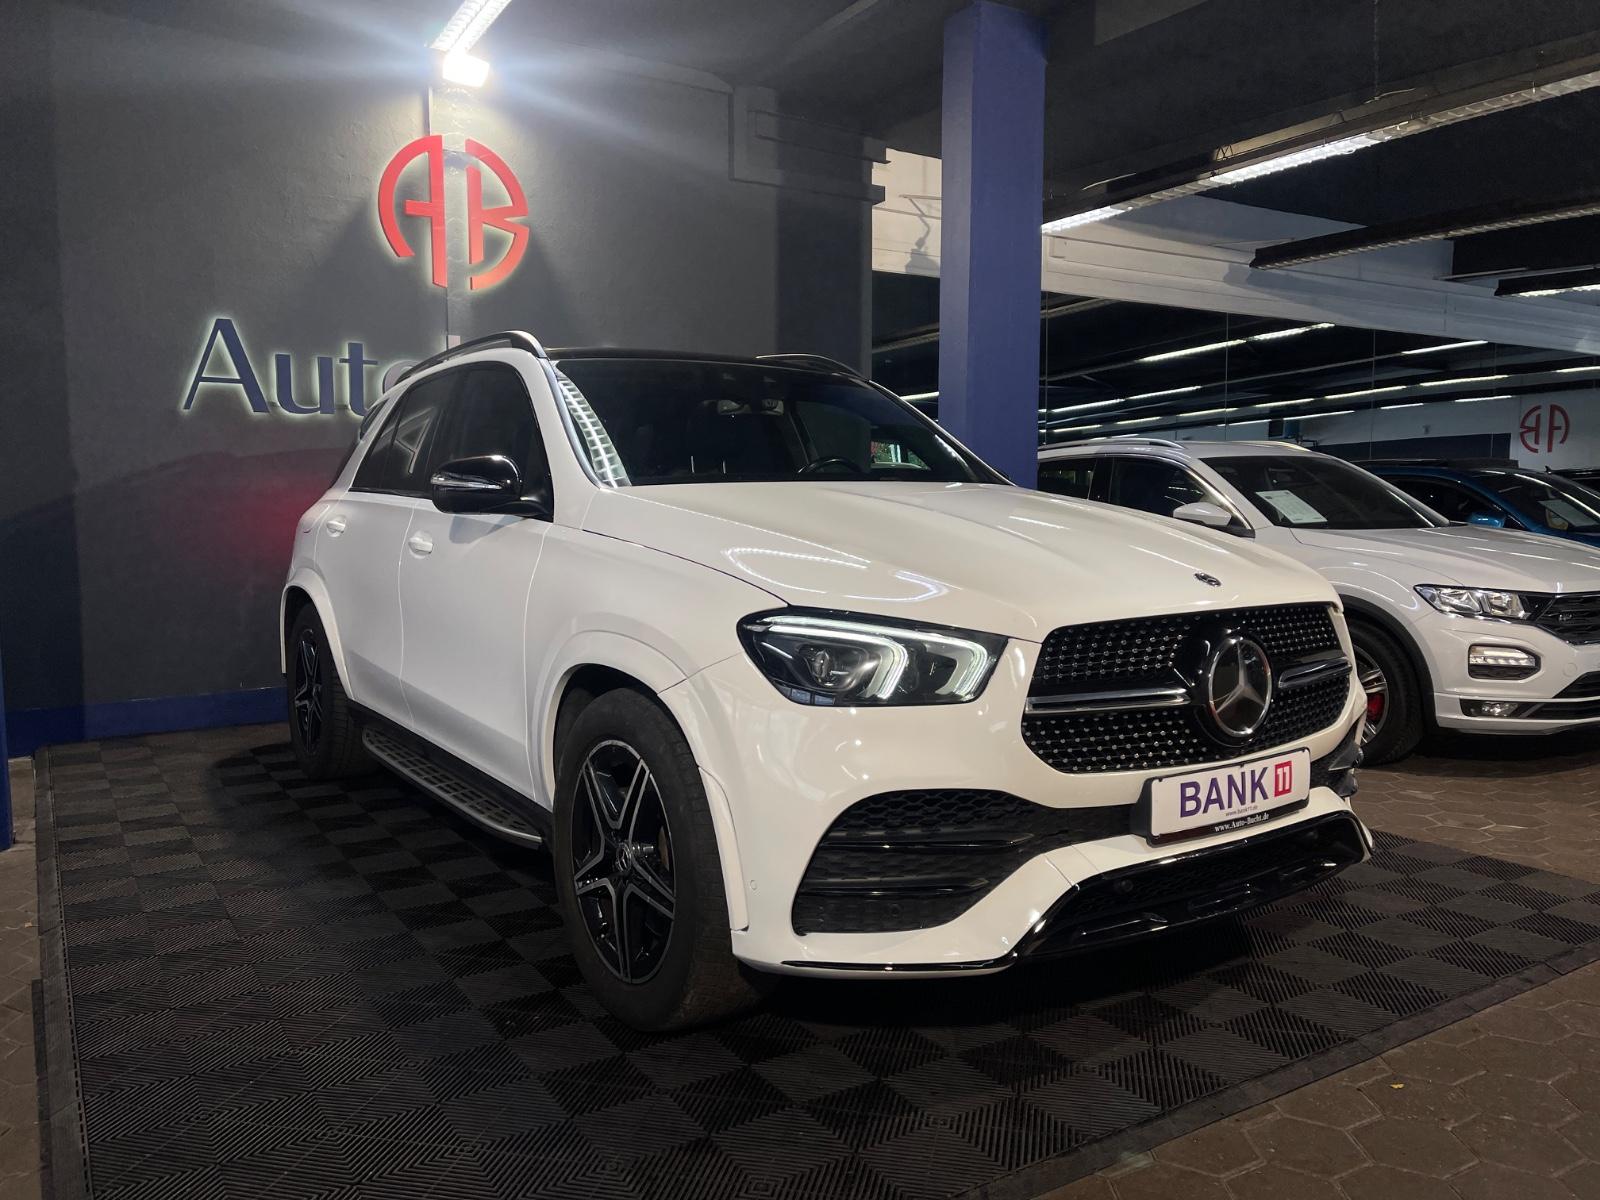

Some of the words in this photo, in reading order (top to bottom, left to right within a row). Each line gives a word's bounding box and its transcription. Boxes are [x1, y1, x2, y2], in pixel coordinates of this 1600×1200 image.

[378, 134, 530, 290] AB
[1180, 767, 1269, 818] BANK
[1275, 764, 1292, 794] 11
